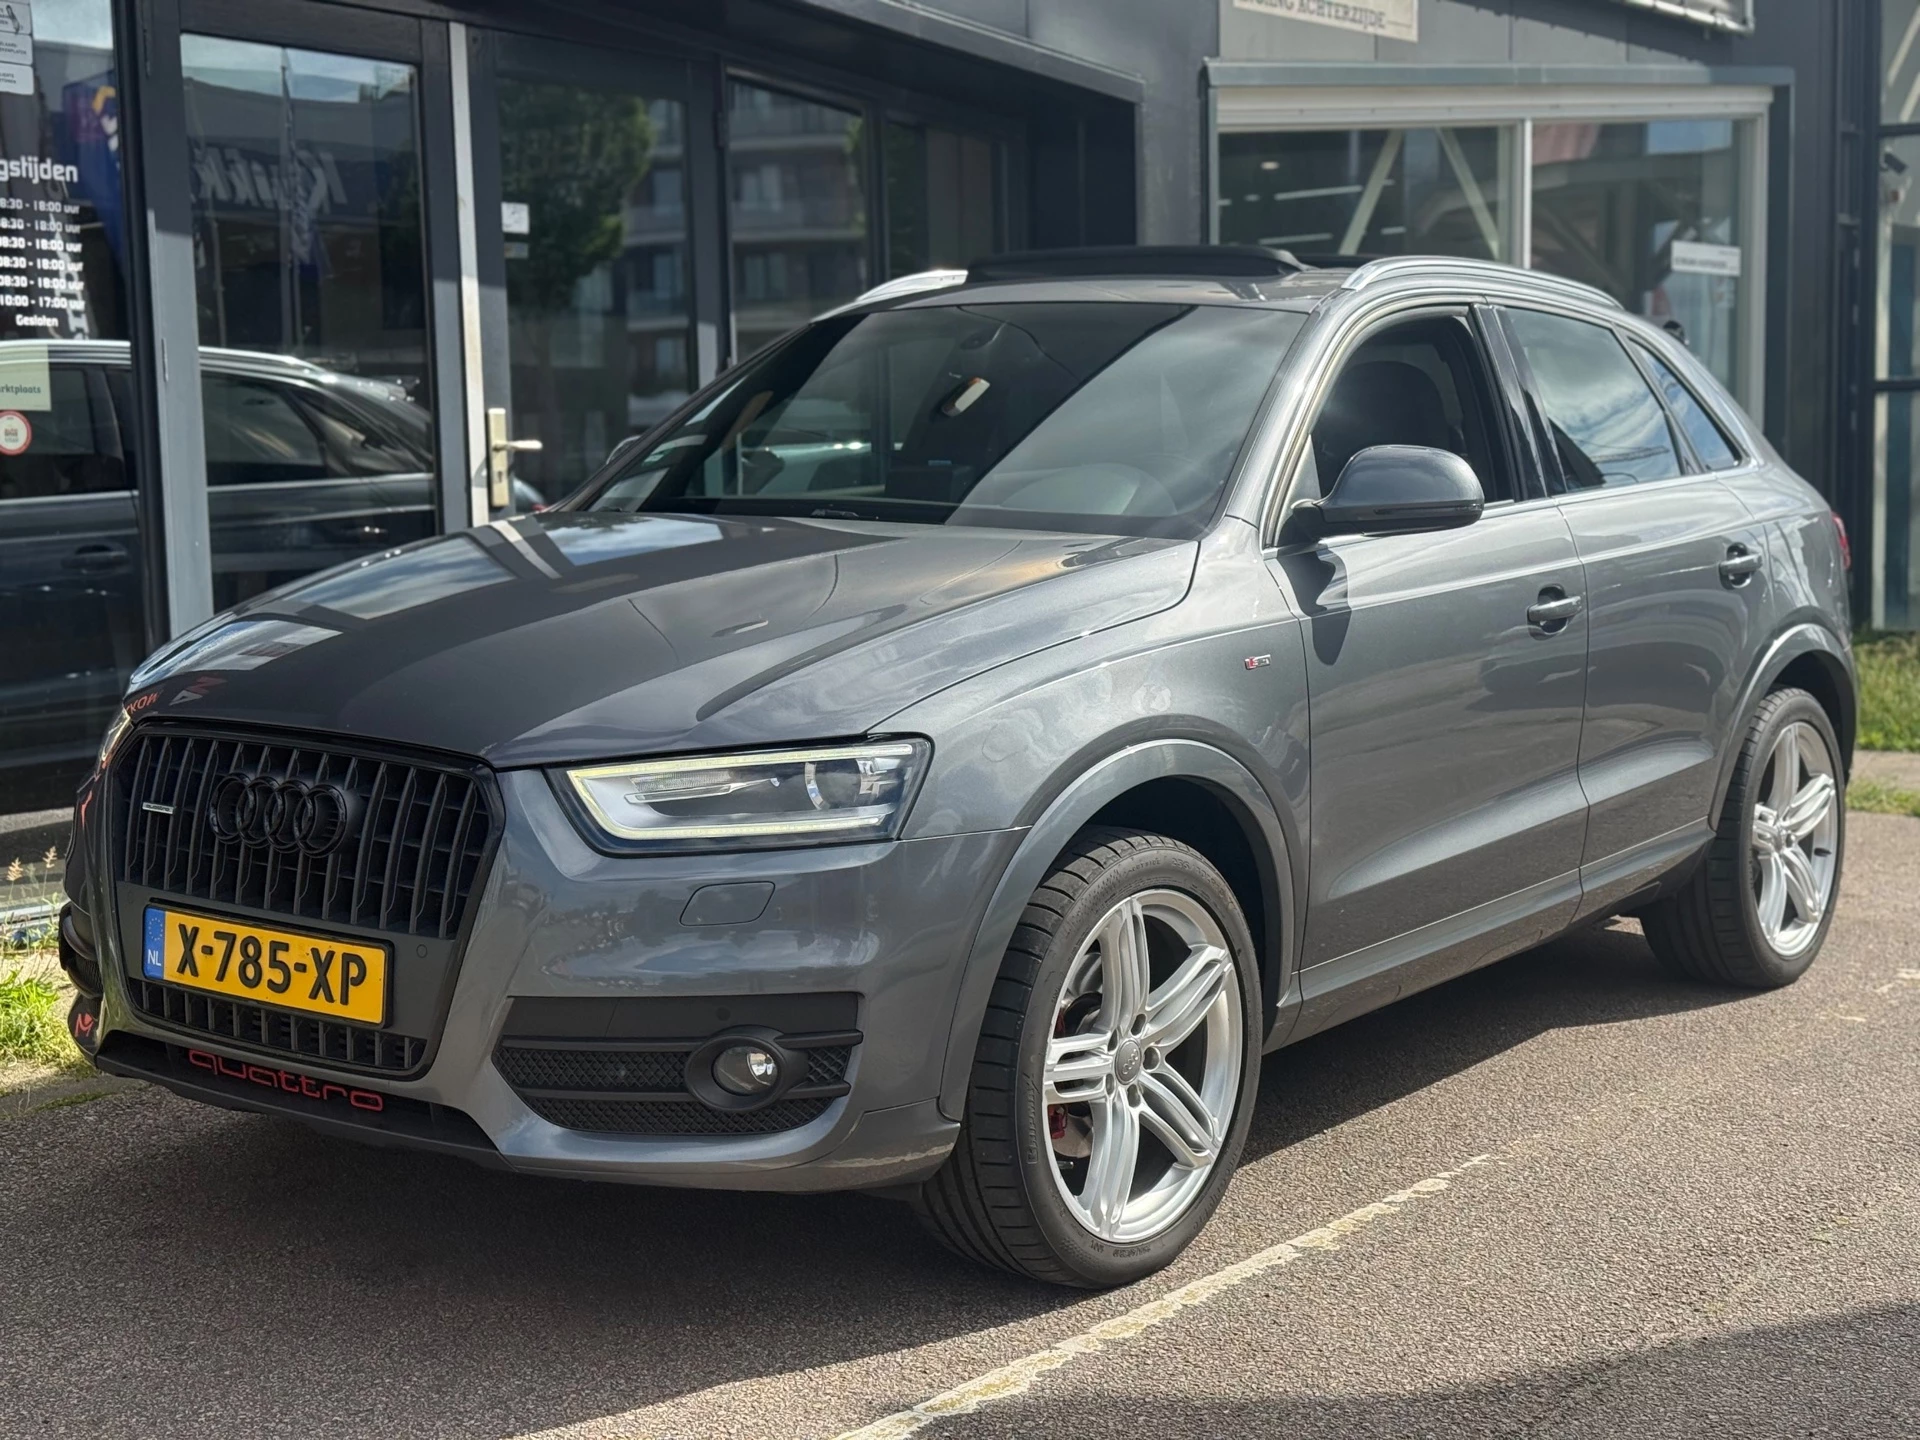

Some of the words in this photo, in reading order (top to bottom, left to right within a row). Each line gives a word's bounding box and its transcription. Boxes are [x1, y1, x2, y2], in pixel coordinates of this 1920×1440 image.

[1298, 0, 1386, 30] ACHTERZIJDE
[0, 156, 78, 184] gstijden
[34, 200, 61, 213] 18:00
[35, 219, 62, 232] 18:00
[36, 238, 64, 250] 18:00
[36, 257, 65, 270] 18:00
[38, 277, 66, 289] 18:00
[0, 294, 29, 307] 10:00
[39, 296, 67, 309] 17:00
[15, 313, 59, 327] Gesloten
[0, 383, 41, 396] rktplaats
[147, 948, 162, 967] NL
[176, 922, 367, 1006] X-785-XP
[189, 1048, 384, 1112] quattro
